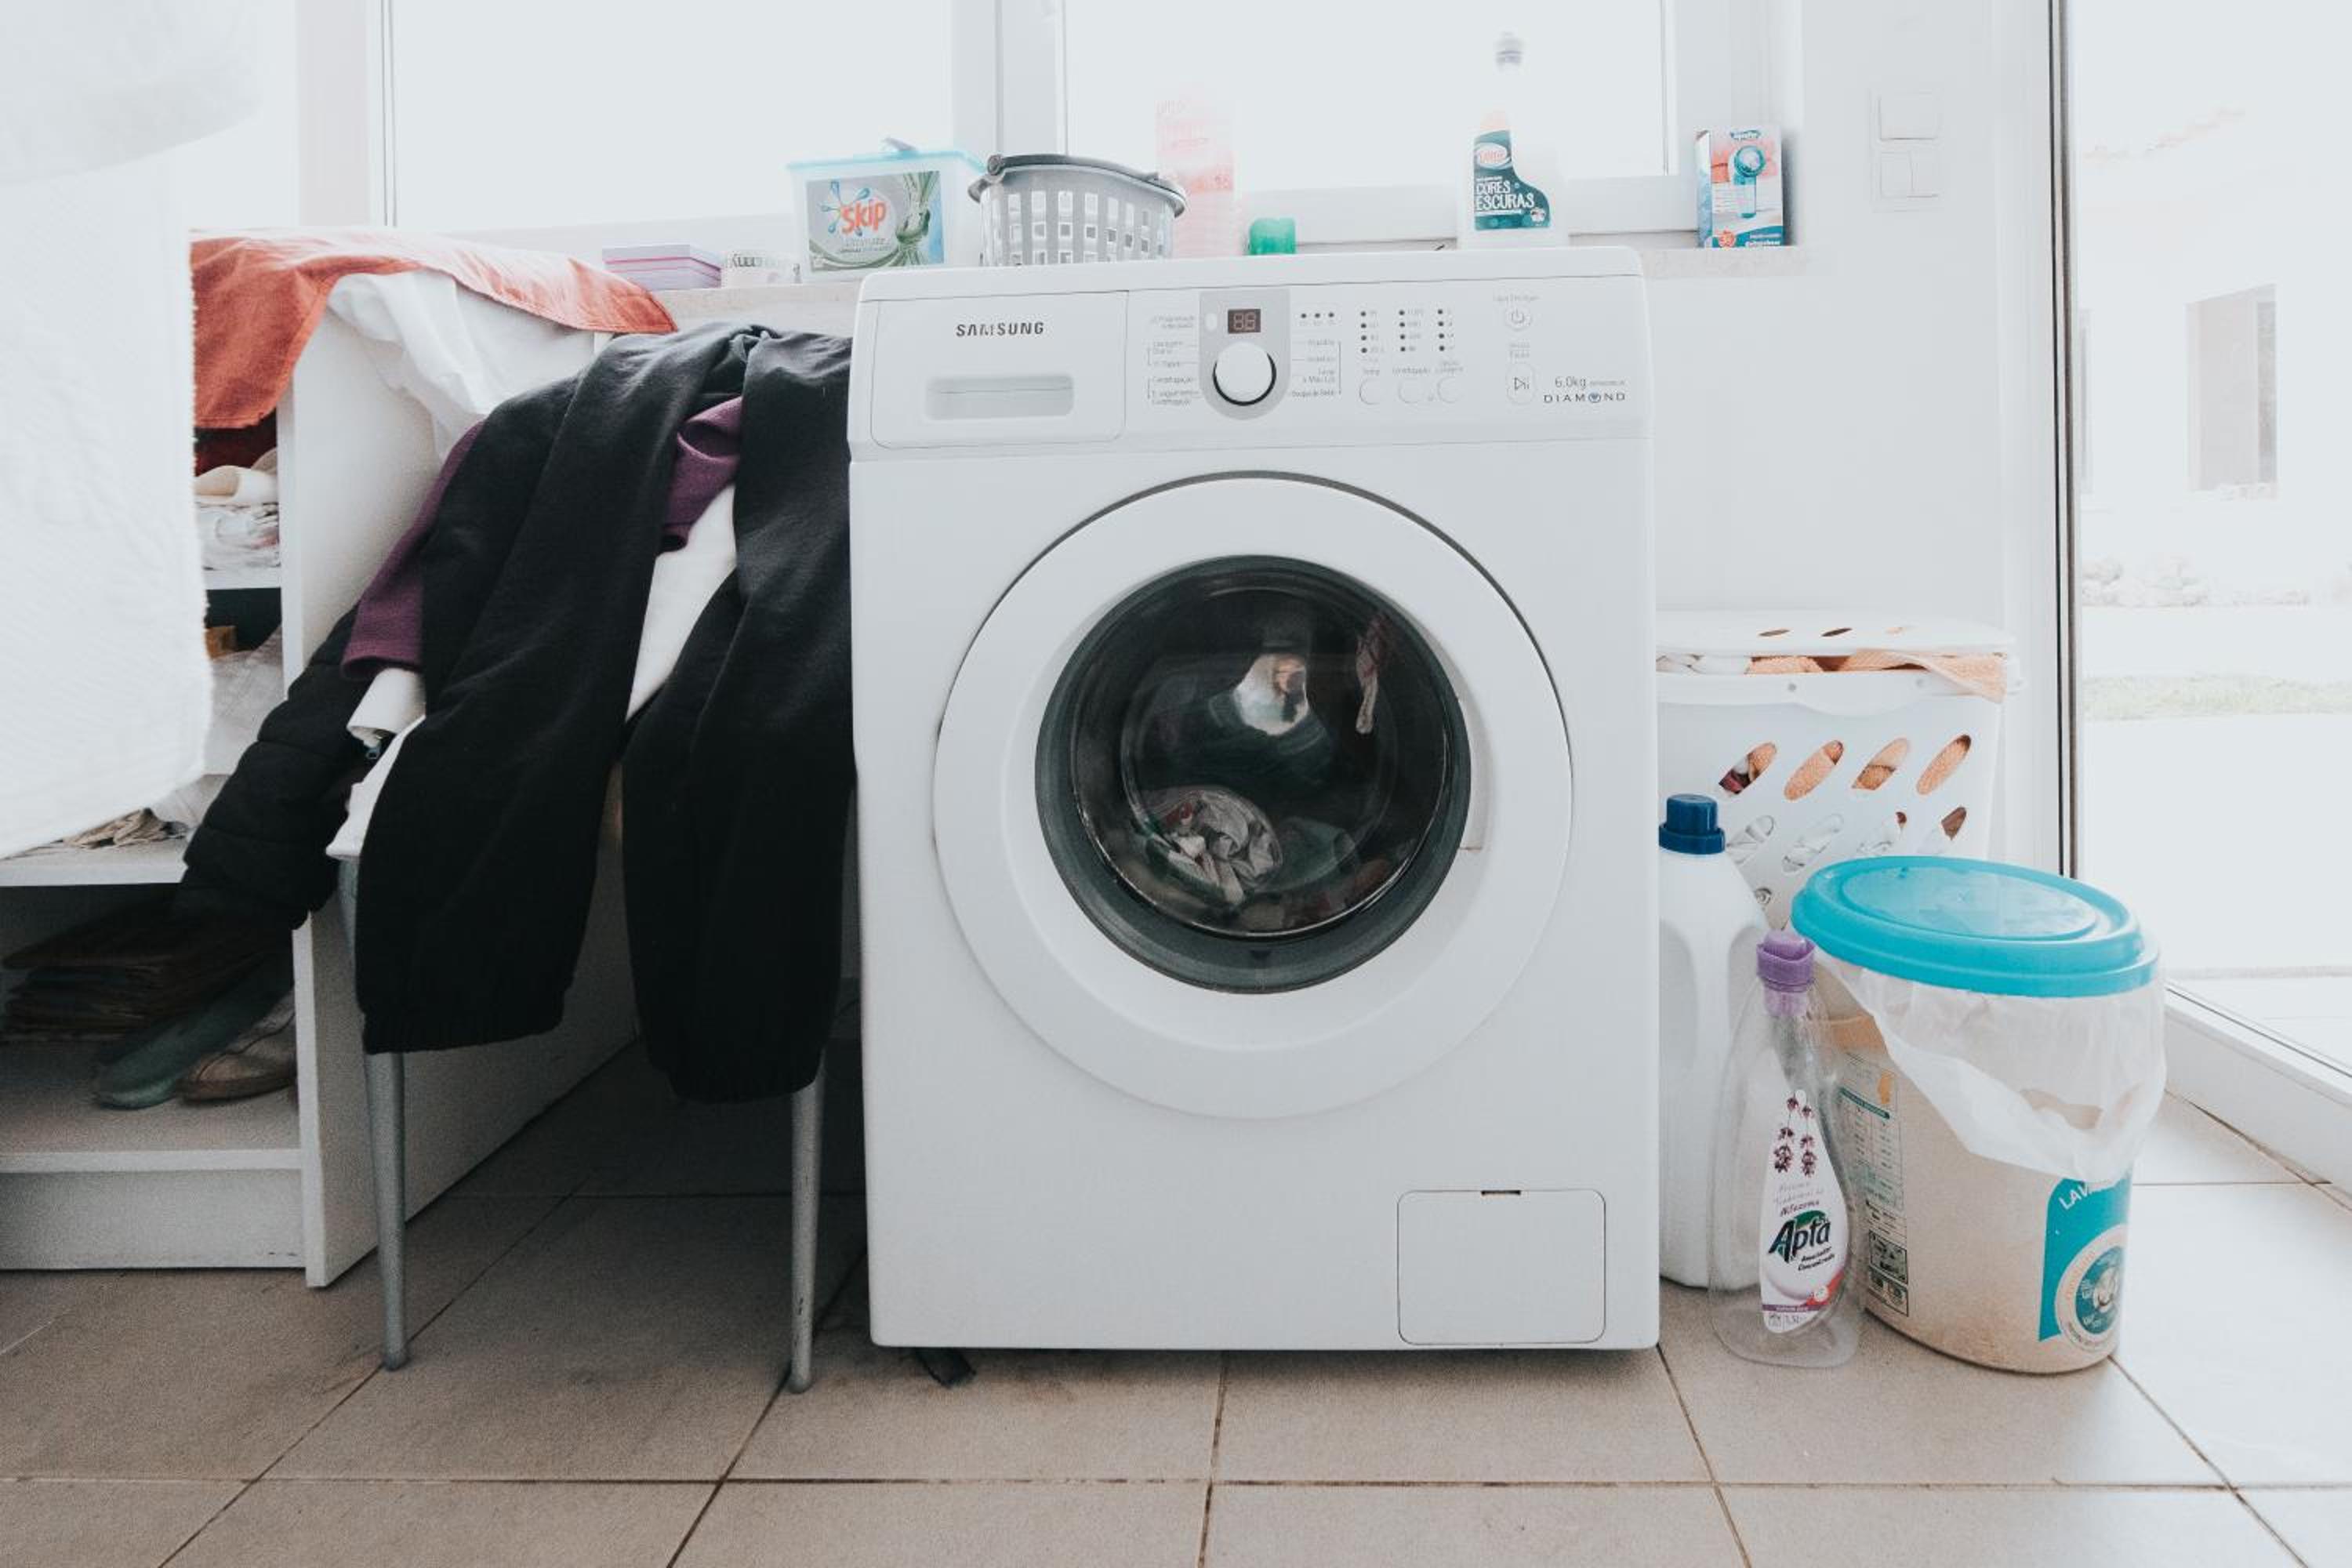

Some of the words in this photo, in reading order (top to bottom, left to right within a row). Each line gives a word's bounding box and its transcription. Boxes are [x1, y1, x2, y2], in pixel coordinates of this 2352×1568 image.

[1476, 181, 1510, 194] CORES
[1476, 193, 1534, 210] ESCURAS
[956, 321, 1044, 336] SAMSUNG
[1543, 392, 1625, 404] DIAMOND
[1768, 1217, 1831, 1264] Apta
